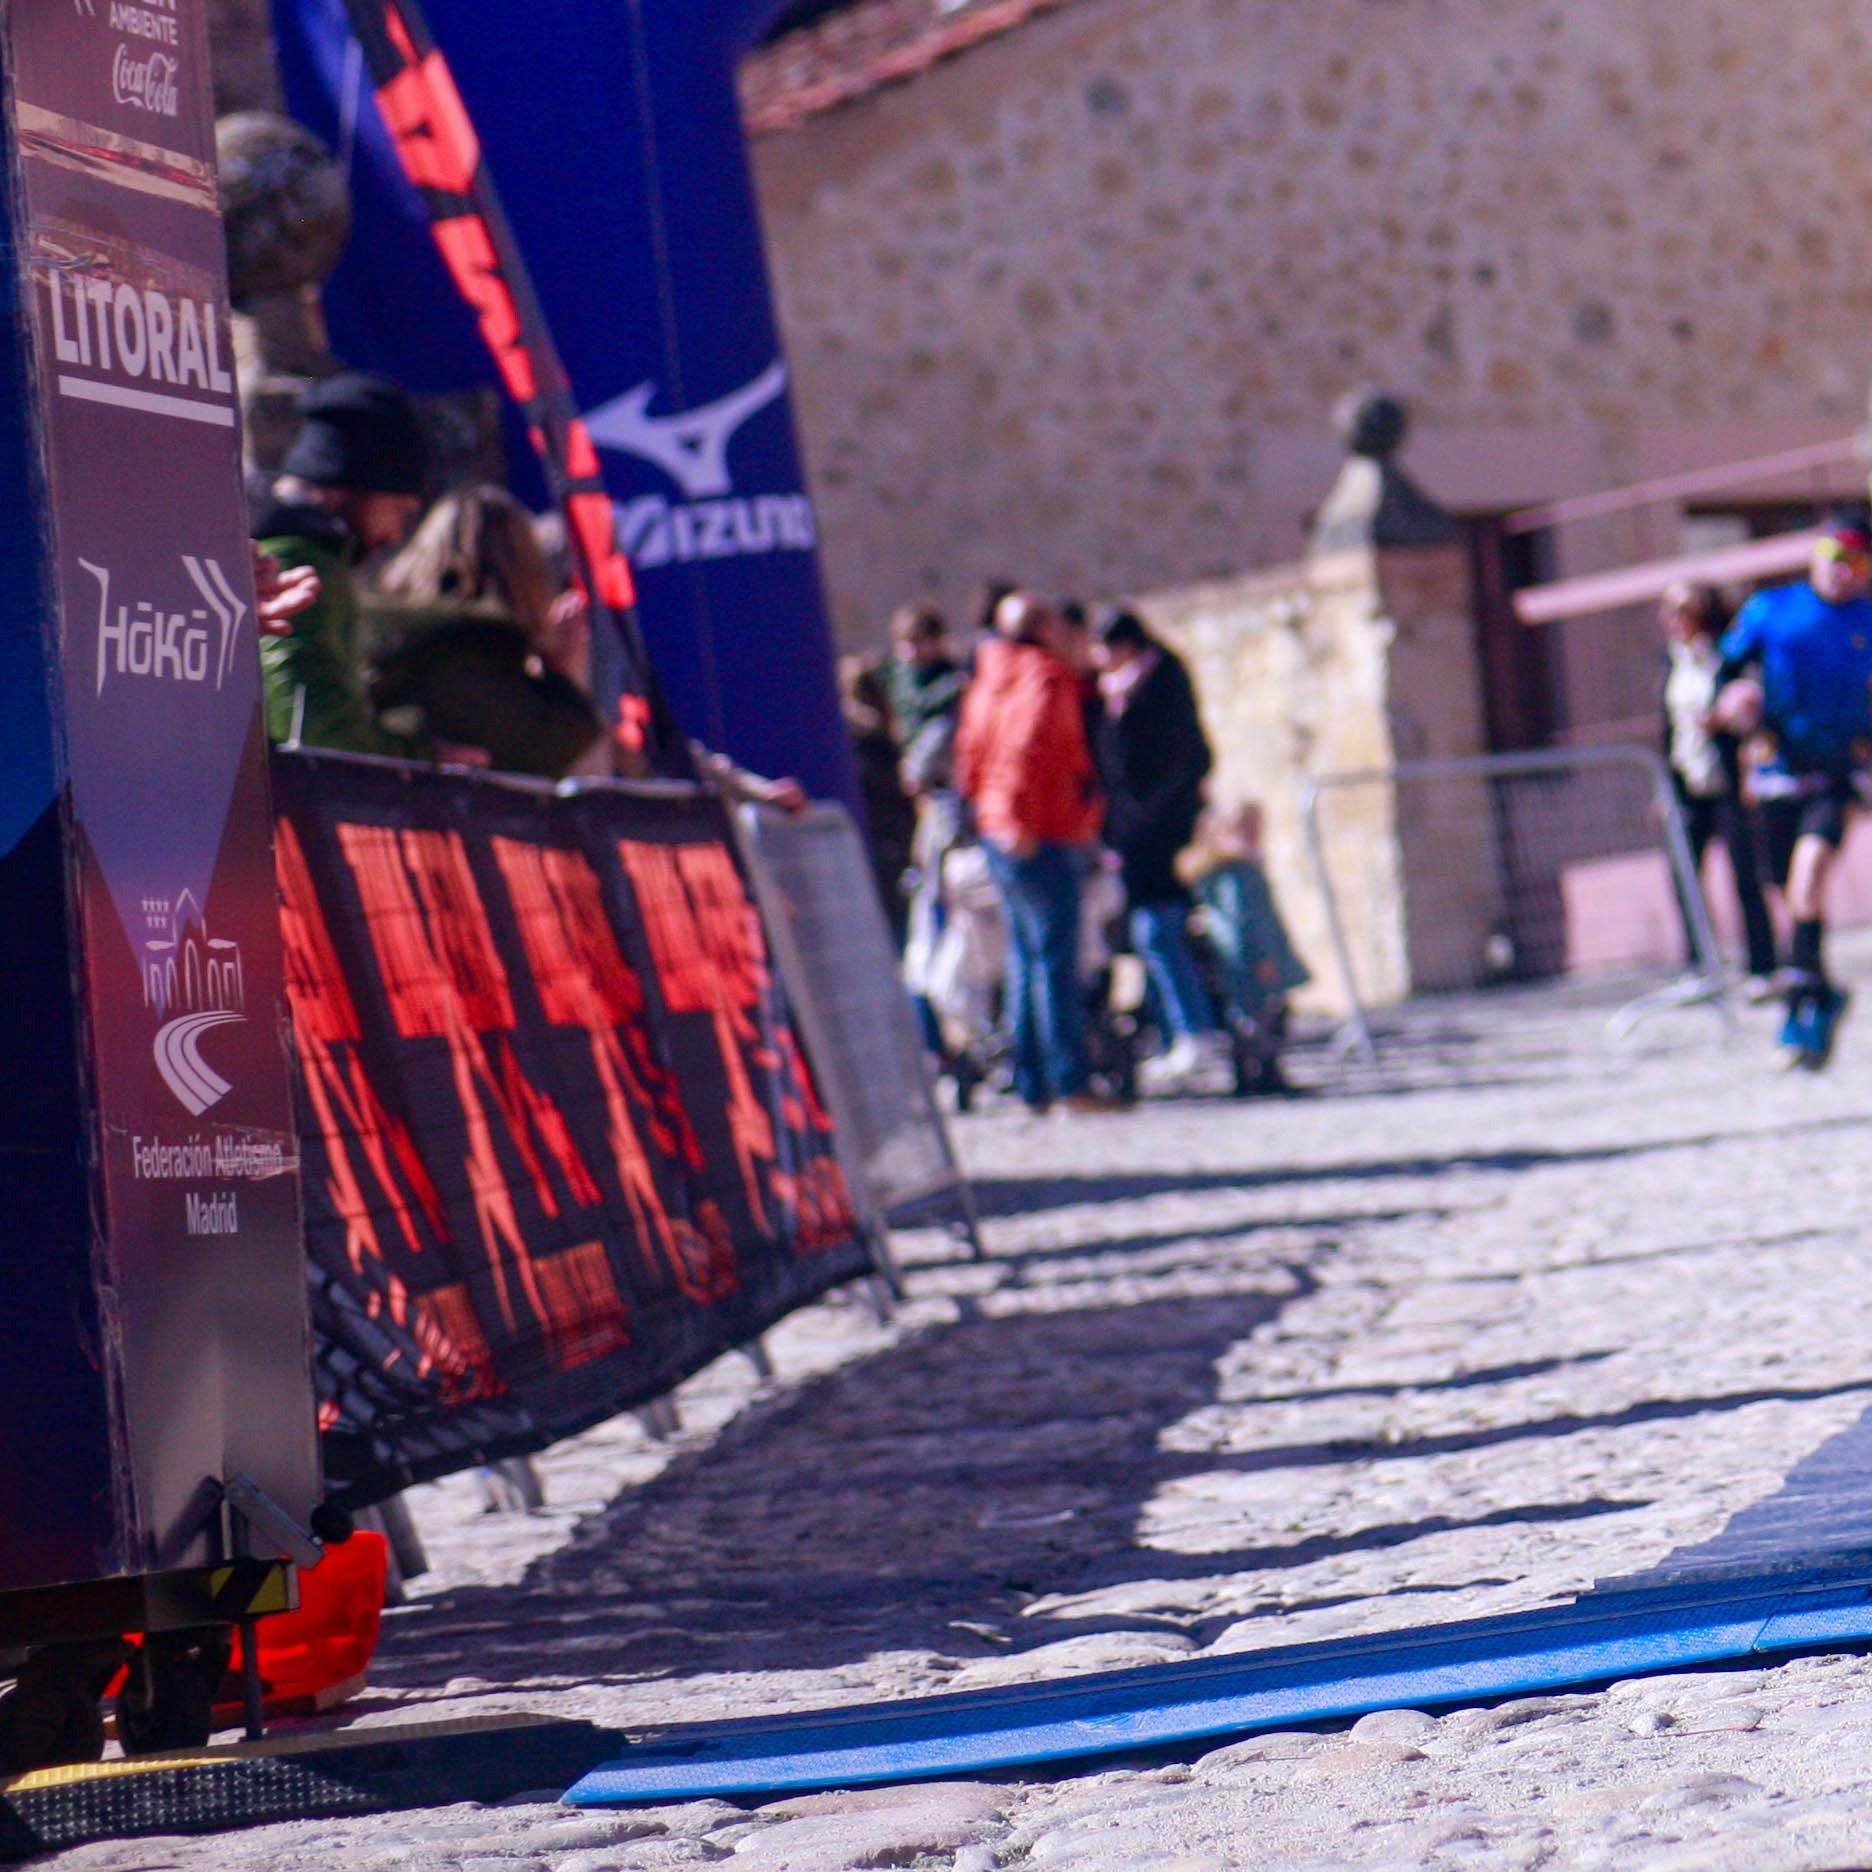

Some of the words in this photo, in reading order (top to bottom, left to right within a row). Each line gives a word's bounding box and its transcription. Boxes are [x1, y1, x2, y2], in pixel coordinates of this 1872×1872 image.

[109, 1, 179, 46] AMBIENTE
[50, 267, 232, 395] LITORAL
[132, 1133, 214, 1179] Federación
[185, 1191, 239, 1235] Madrid
